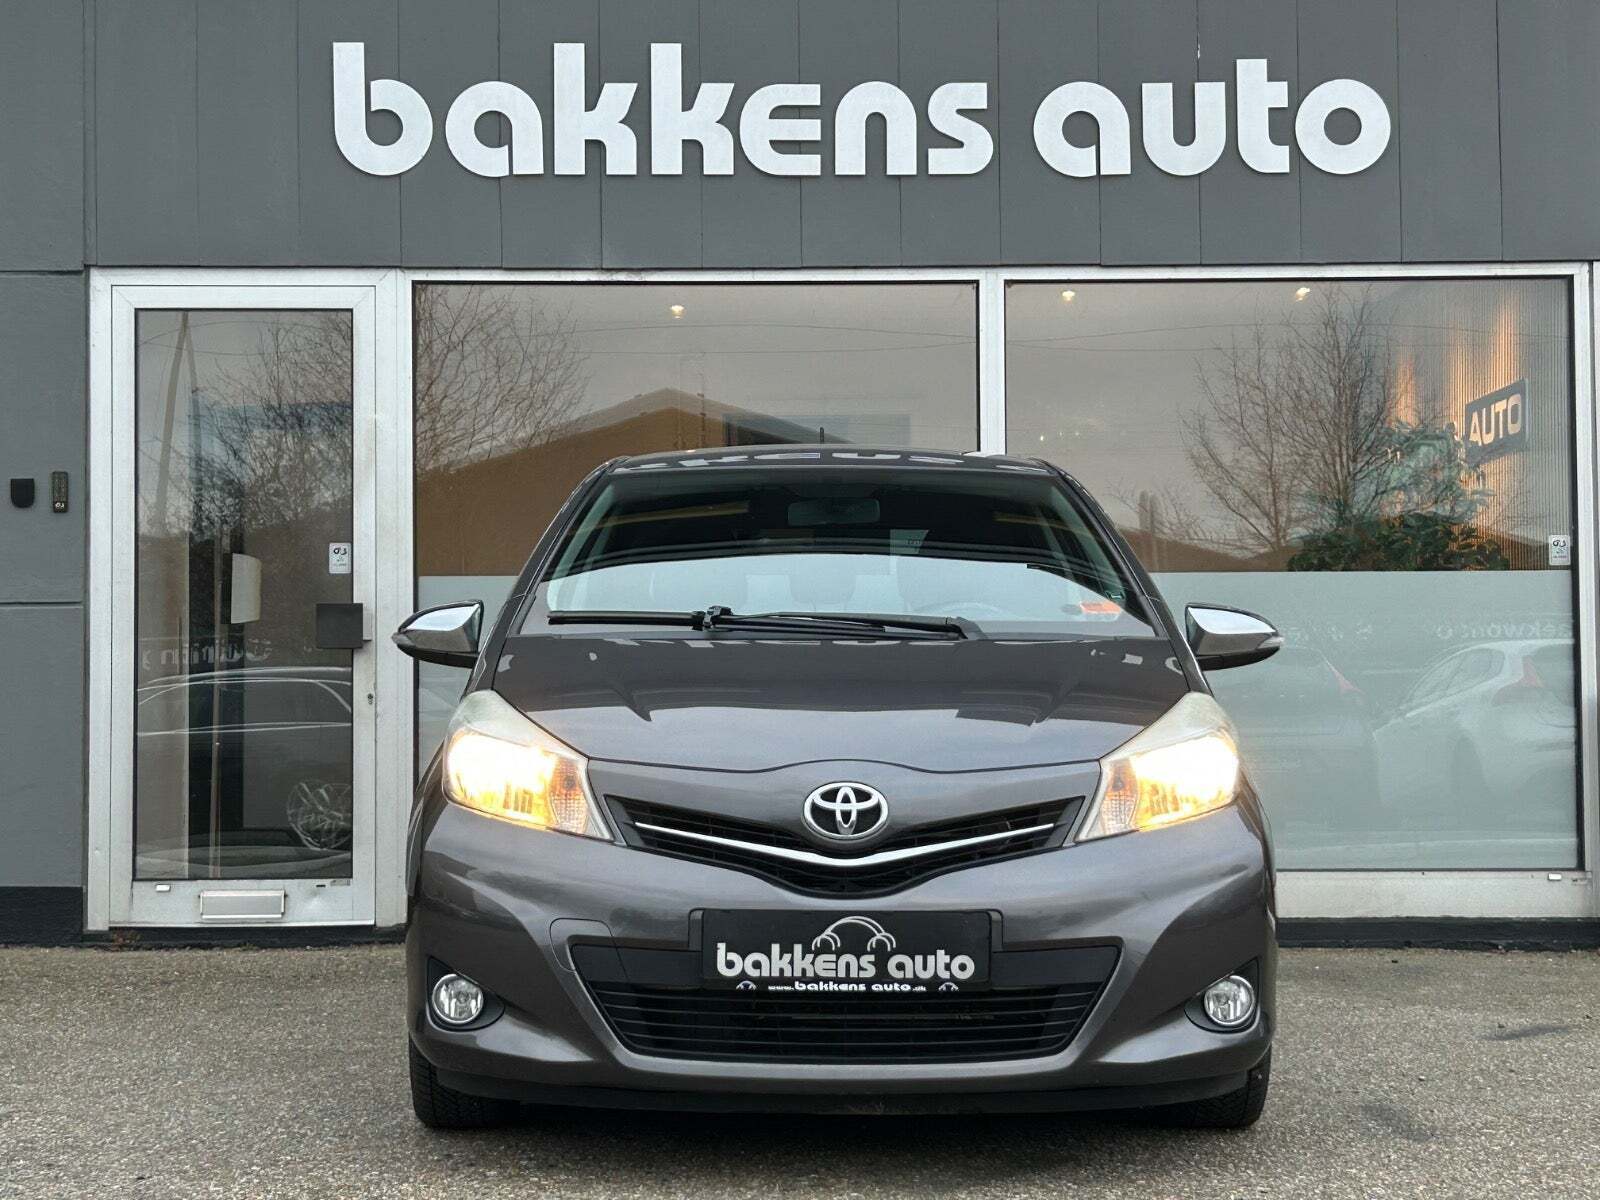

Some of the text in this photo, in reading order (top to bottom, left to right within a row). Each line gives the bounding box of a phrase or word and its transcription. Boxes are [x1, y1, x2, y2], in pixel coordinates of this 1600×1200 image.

[333, 42, 1391, 177] bakkens auto
[1468, 393, 1522, 447] AUTO
[716, 942, 975, 979] bakkens auto
